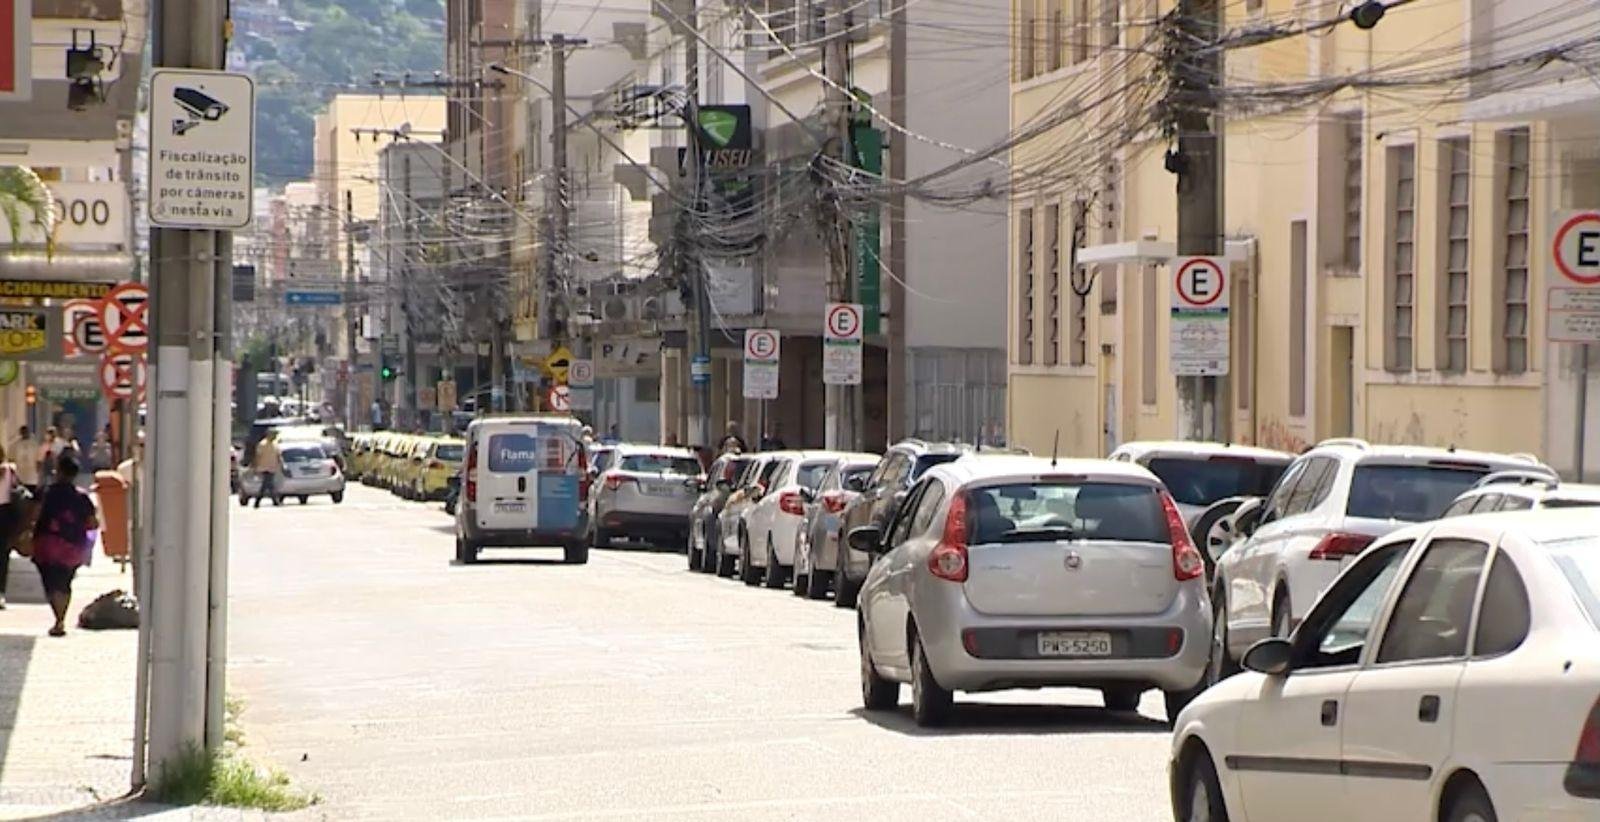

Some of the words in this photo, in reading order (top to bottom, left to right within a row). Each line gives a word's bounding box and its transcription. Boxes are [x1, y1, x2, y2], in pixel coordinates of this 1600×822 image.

[160, 149, 247, 166] Fiscalização
[166, 168, 183, 179] de
[186, 169, 240, 182] trânsito
[160, 187, 183, 199] por
[187, 187, 245, 200] câmeras
[172, 205, 209, 217] nesta
[213, 206, 233, 217] via
[1576, 231, 1600, 267] E
[1192, 268, 1208, 295] E
[838, 312, 849, 331] E
[85, 321, 103, 346] E
[757, 336, 768, 352] E
